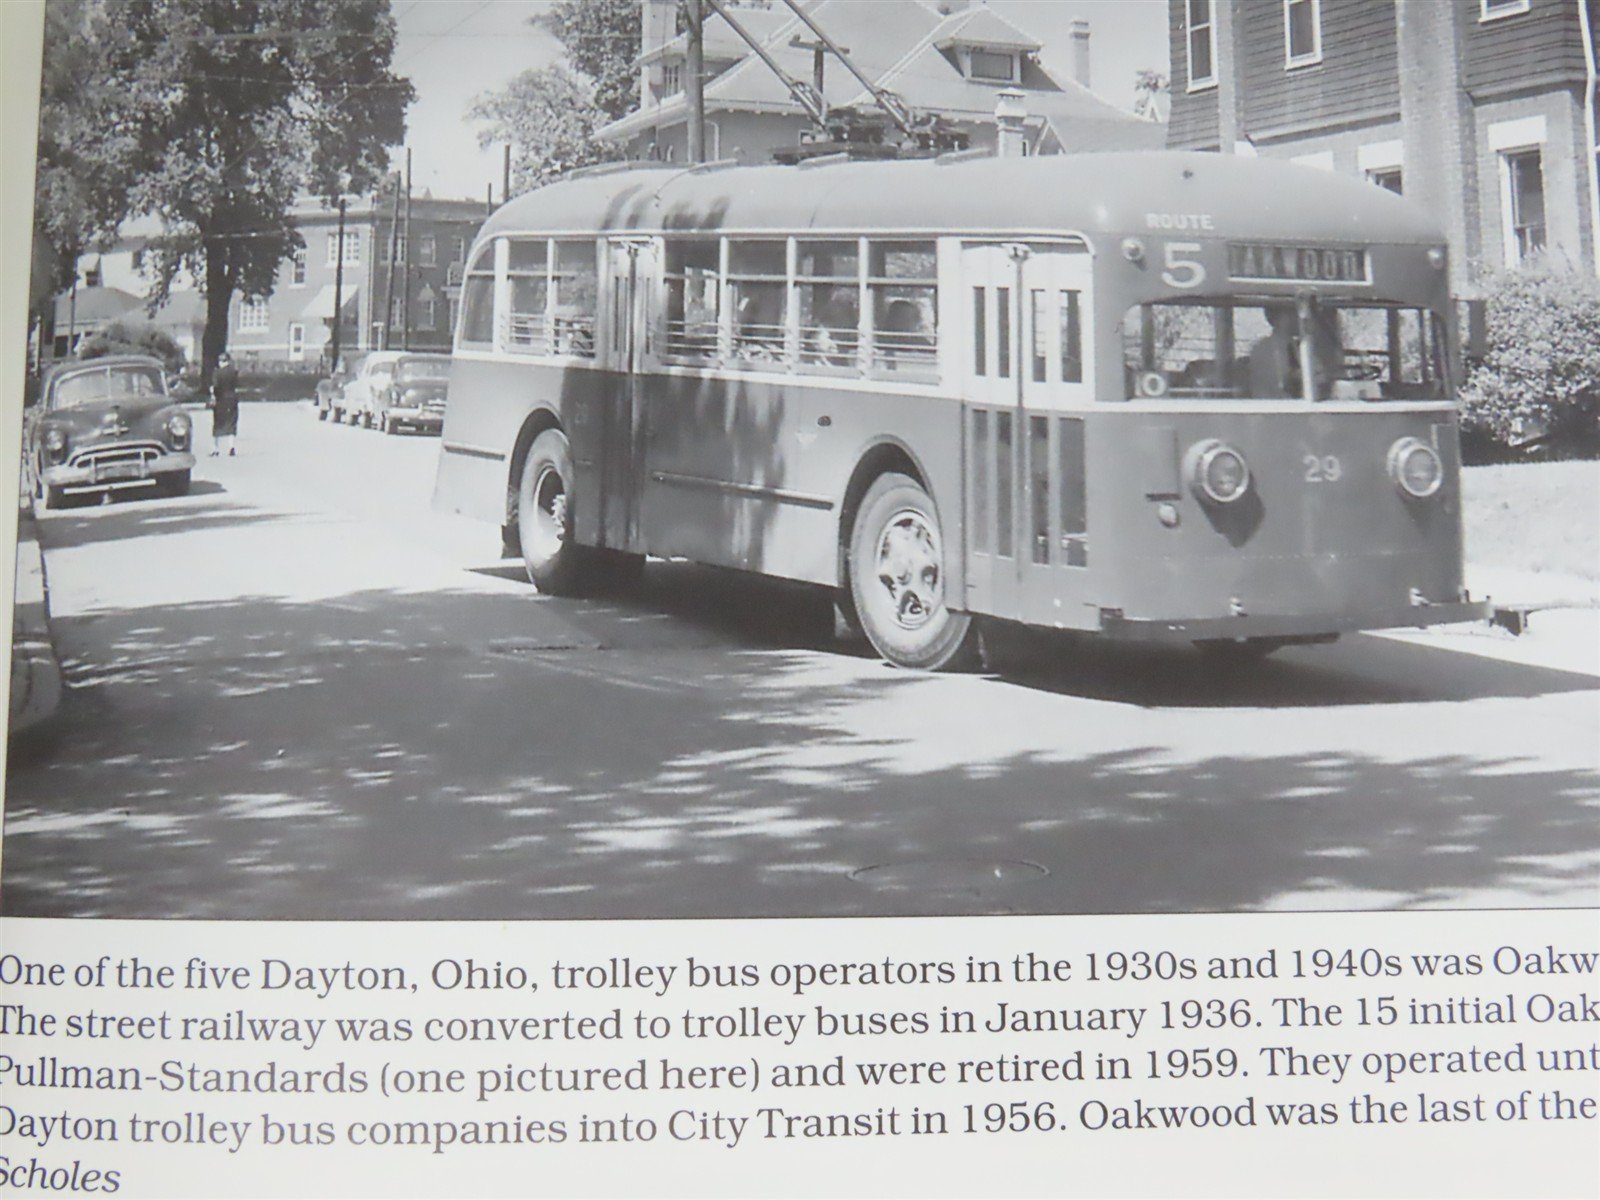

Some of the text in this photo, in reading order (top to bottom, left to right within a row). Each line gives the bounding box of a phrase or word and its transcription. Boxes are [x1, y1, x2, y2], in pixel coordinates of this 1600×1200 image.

[1146, 213, 1214, 230] ROUTE
[1161, 242, 1206, 288] 5
[1302, 455, 1342, 482] 29
[0, 945, 1600, 1000] One of the five Dayton, Ohio, trolley bus operators in the 1930s and 1940s was Oakw
[0, 992, 1600, 1051] The street railway was converted to trolley buses in January 1936. The 15 initial Oak
[380, 1062, 465, 1098] (one
[476, 1058, 649, 1102] pictured
[659, 1057, 760, 1093] here)
[771, 1055, 846, 1088] and
[855, 1061, 946, 1086] were
[957, 1050, 1085, 1083] retired
[1095, 1052, 1133, 1080] in
[1146, 1047, 1249, 1079] 1959.
[1258, 1046, 1353, 1085] They
[1362, 1042, 1527, 1084] operated
[1536, 1043, 1600, 1072] unt
[128, 1112, 252, 1154] trolley
[261, 1113, 336, 1145] bus
[347, 1115, 568, 1154] companies
[578, 1112, 657, 1143] into
[668, 1109, 749, 1149] City
[756, 1106, 902, 1139] Transit
[911, 1106, 950, 1135] in
[963, 1100, 1067, 1134] 1956.
[1079, 1096, 1258, 1131] Oakwood
[1265, 1102, 1339, 1126] was
[1348, 1093, 1408, 1125] the
[1417, 1092, 1487, 1123] last
[1495, 1089, 1532, 1122] of
[1538, 1090, 1597, 1121] the
